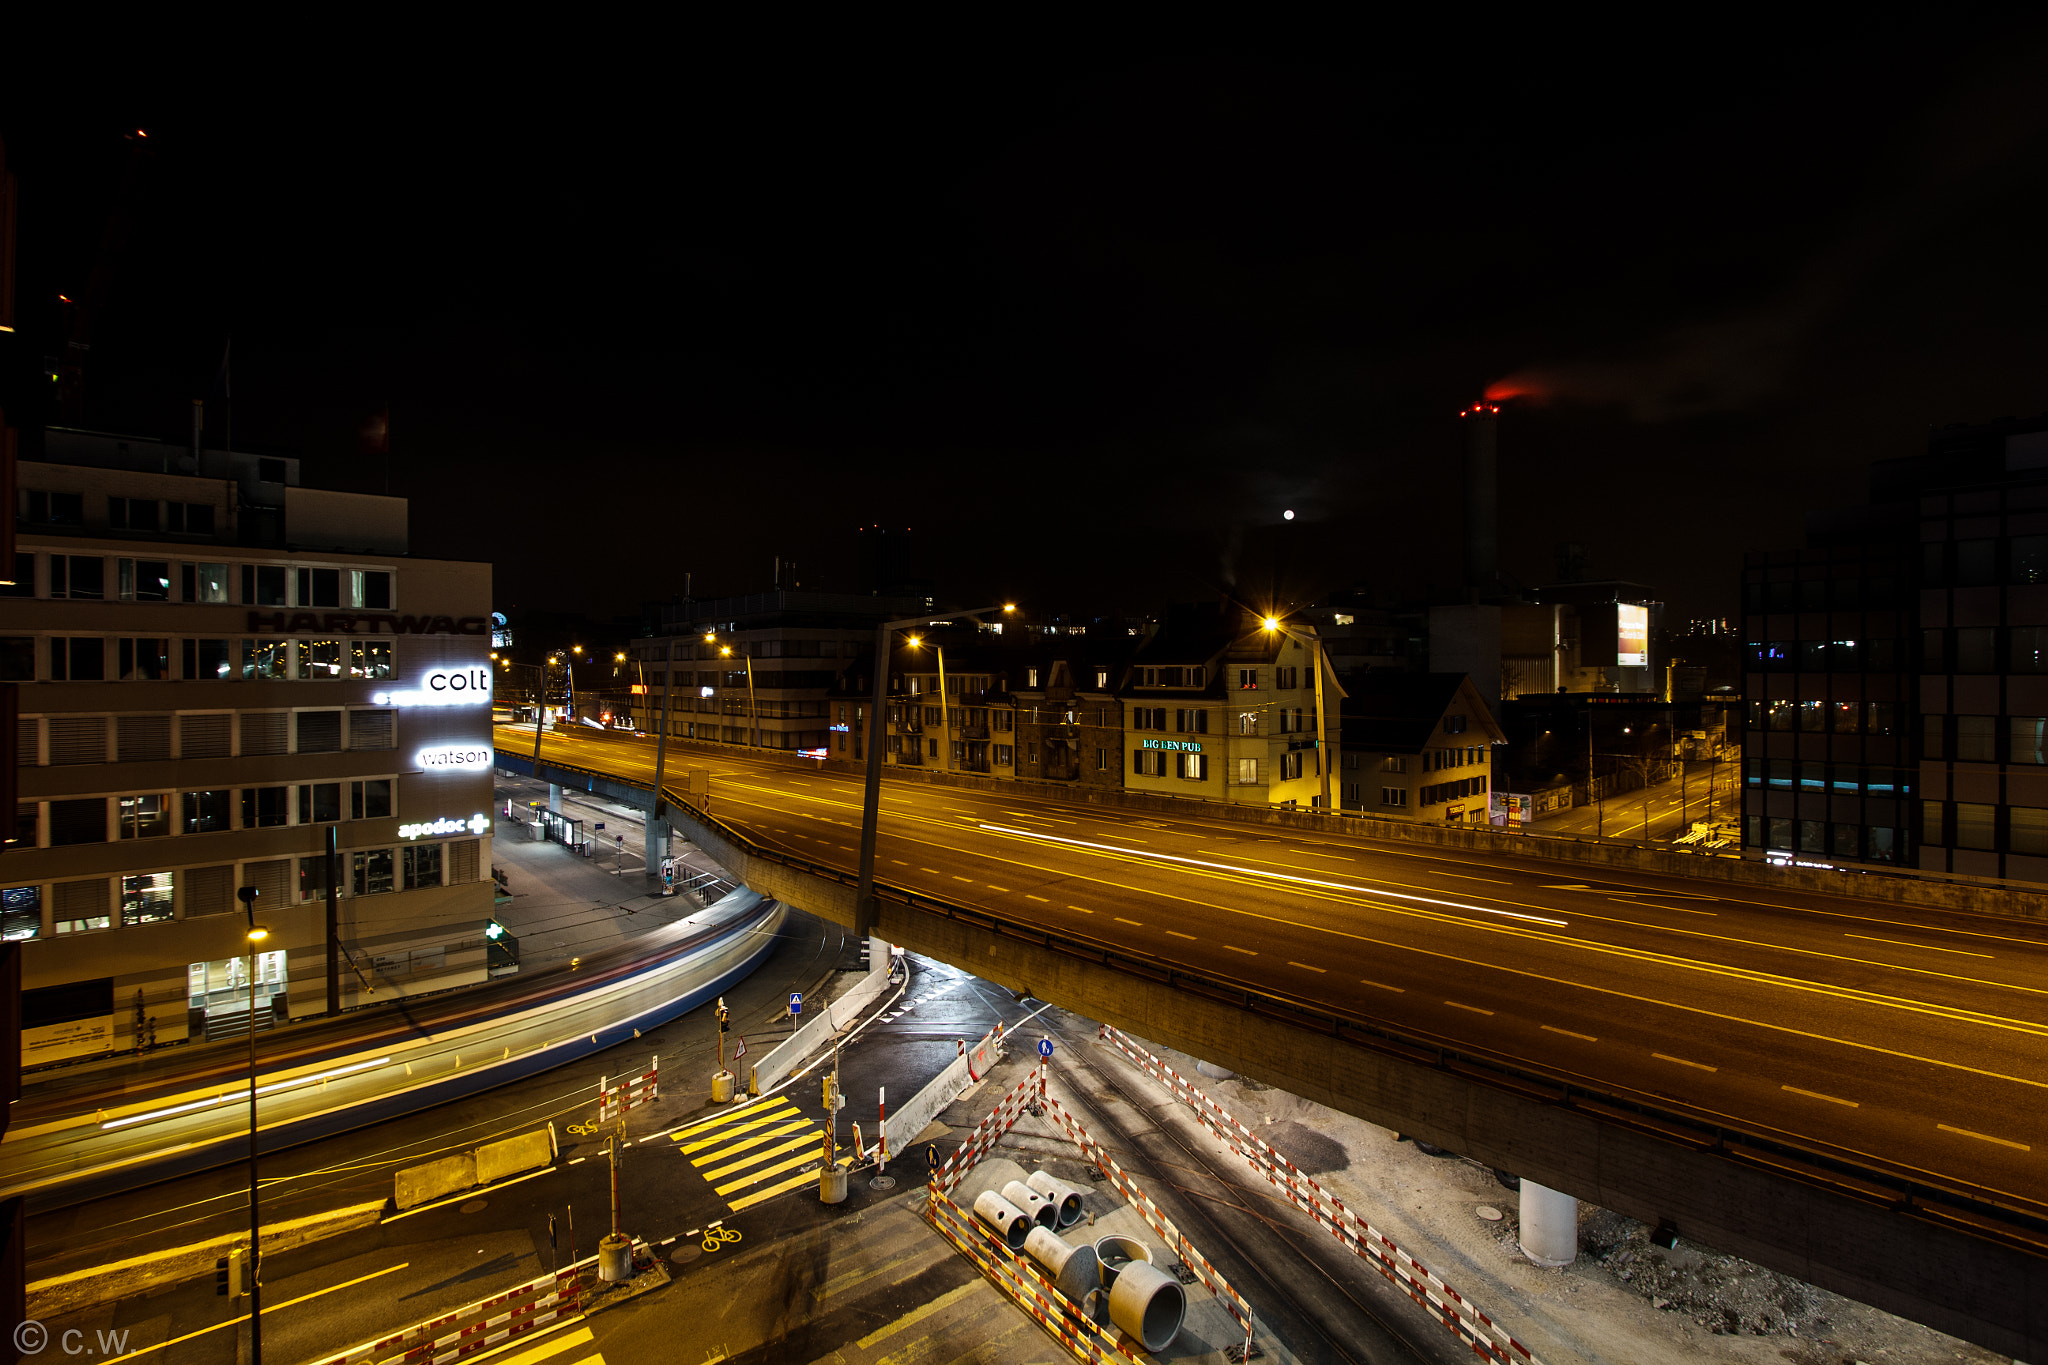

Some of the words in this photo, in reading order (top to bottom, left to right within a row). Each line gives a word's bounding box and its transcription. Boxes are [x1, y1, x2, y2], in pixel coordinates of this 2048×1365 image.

[248, 611, 486, 635] HARTWAG
[429, 670, 488, 691] colt
[1143, 739, 1160, 749] BIG
[1161, 740, 1180, 751] BEN
[1181, 741, 1202, 752] PUB
[422, 750, 488, 766] watson
[398, 817, 465, 841] apodoc
